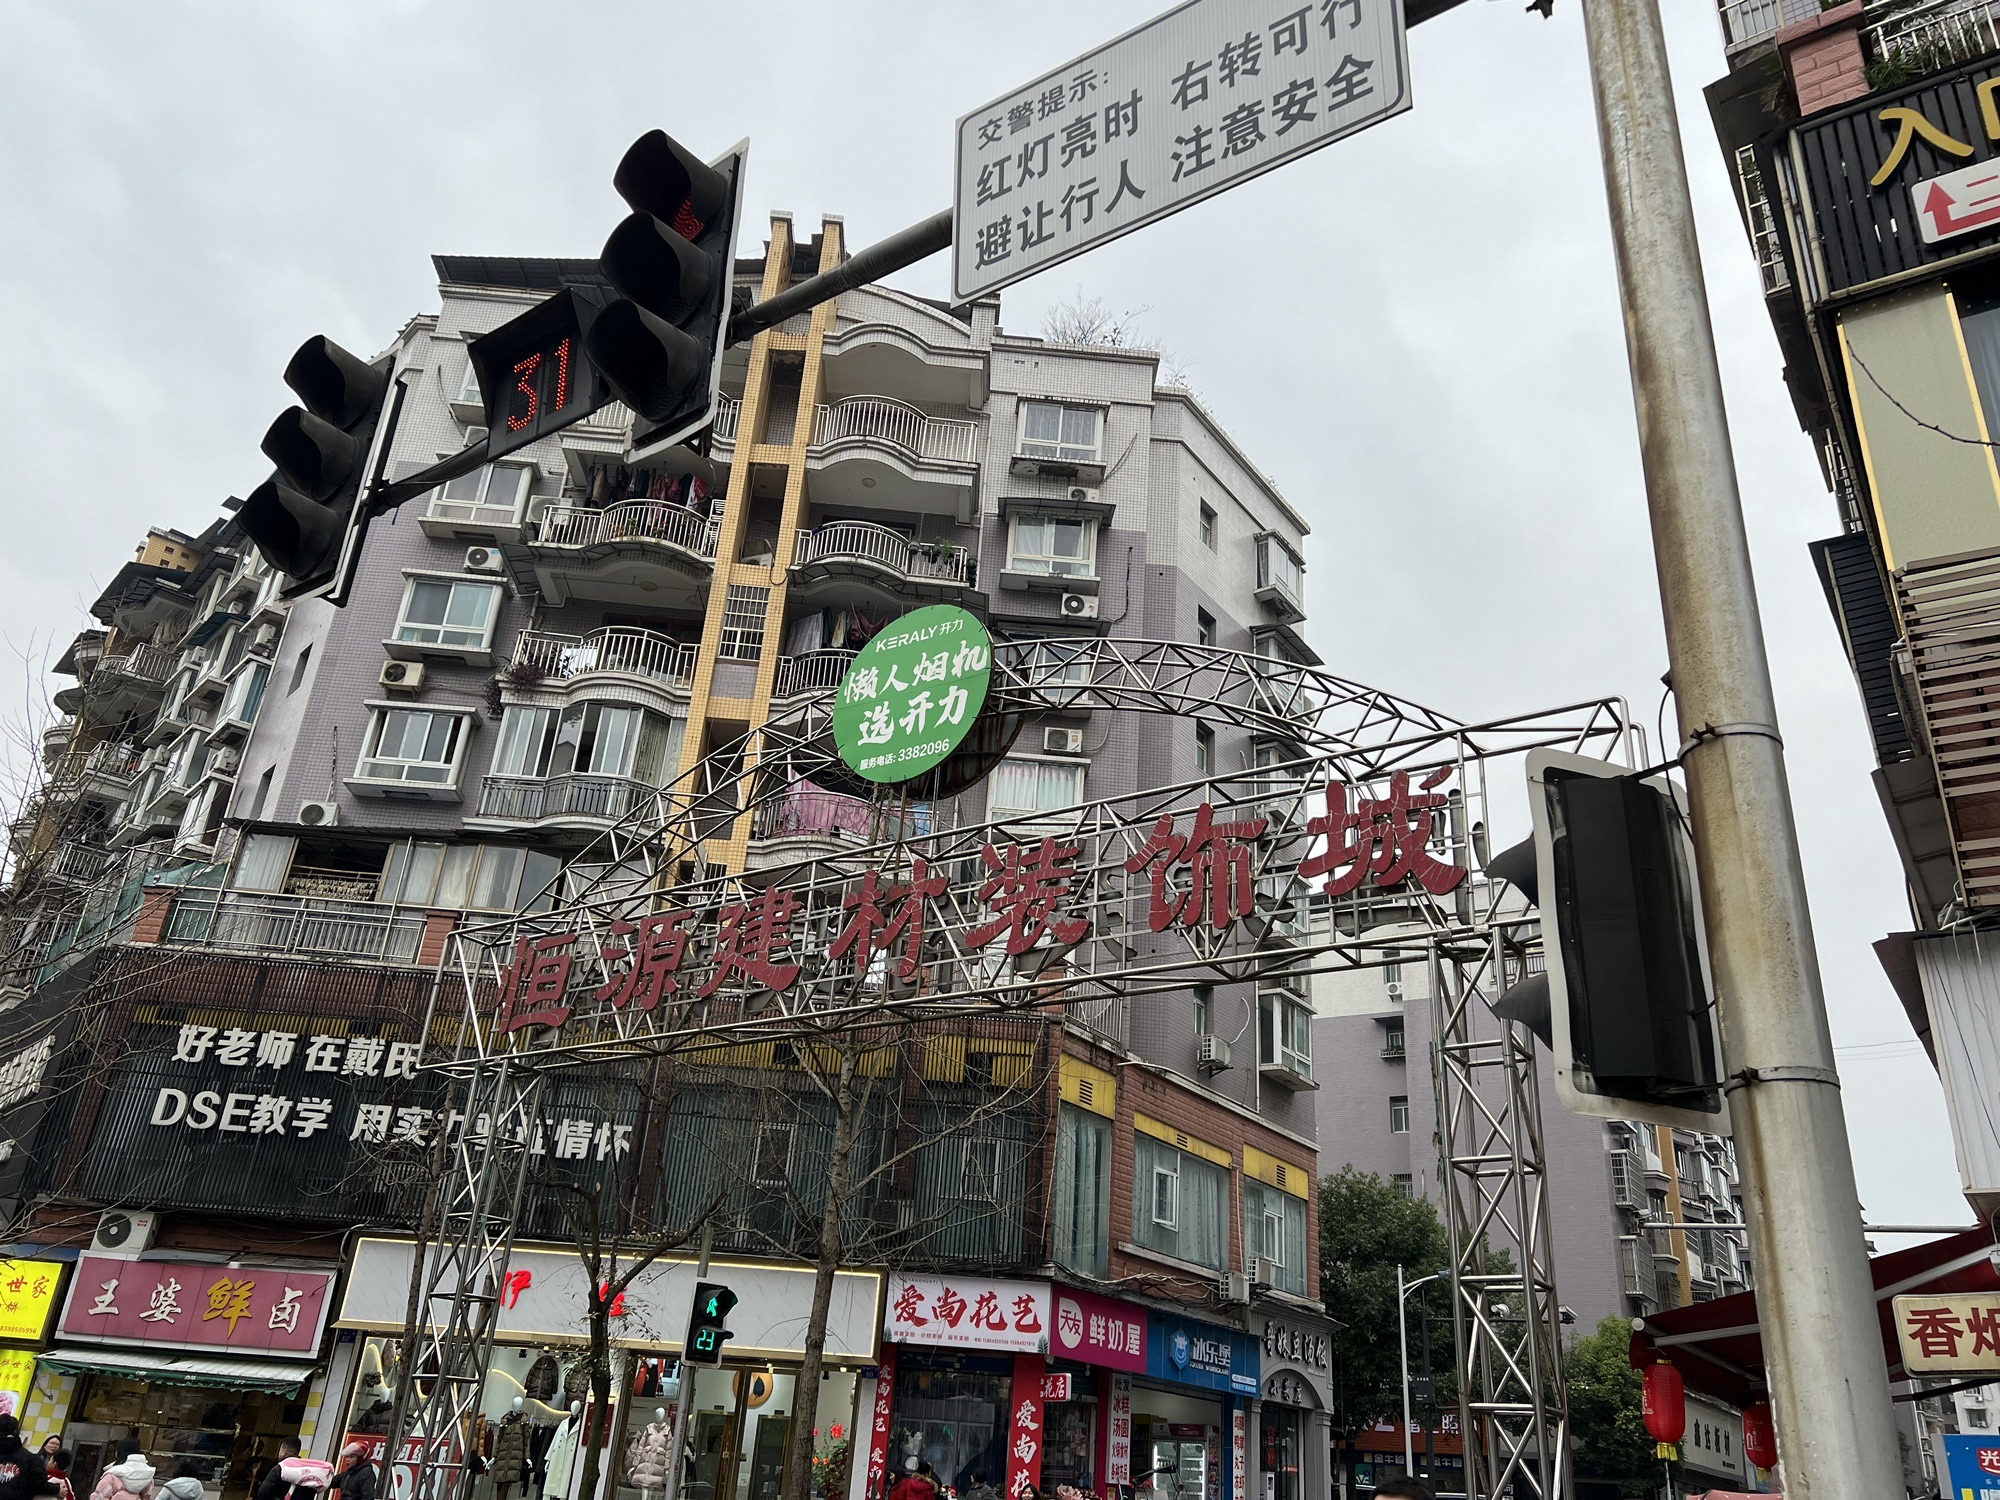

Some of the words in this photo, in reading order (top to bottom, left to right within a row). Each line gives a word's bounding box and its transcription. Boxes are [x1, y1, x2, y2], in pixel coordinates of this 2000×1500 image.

[976, 89, 1143, 207] 红灯亮时
[1171, 0, 1363, 112] 右转可行
[975, 159, 1145, 271] 避让行人
[1171, 54, 1375, 183] 注意安全
[507, 338, 571, 432] 31
[876, 624, 938, 652] KERALY
[939, 619, 963, 636] 开力
[844, 640, 988, 704] 懒人烟机
[857, 685, 968, 746] 选开力
[898, 738, 950, 762] 3382096
[499, 764, 1468, 1036] 恒源建材装饰城
[171, 1024, 298, 1070] 好老师
[305, 1034, 421, 1080] 在戴氏
[150, 1087, 333, 1138] DSE教学
[0, 1272, 50, 1298] 世家
[88, 1275, 303, 1339] 王婆鲜卤
[893, 1284, 1042, 1333] 爱尚花艺
[1089, 1313, 1140, 1355] 鲜奶屋
[1193, 1338, 1230, 1367] 冰乐堡
[1907, 1307, 2000, 1360] 香烟
[875, 1364, 893, 1433] 爱尚花艺
[1045, 1376, 1065, 1399] 花店
[1113, 1394, 1130, 1415] 冰糕
[1114, 1378, 1130, 1393] 批发
[1112, 1418, 1129, 1439] 汤圆
